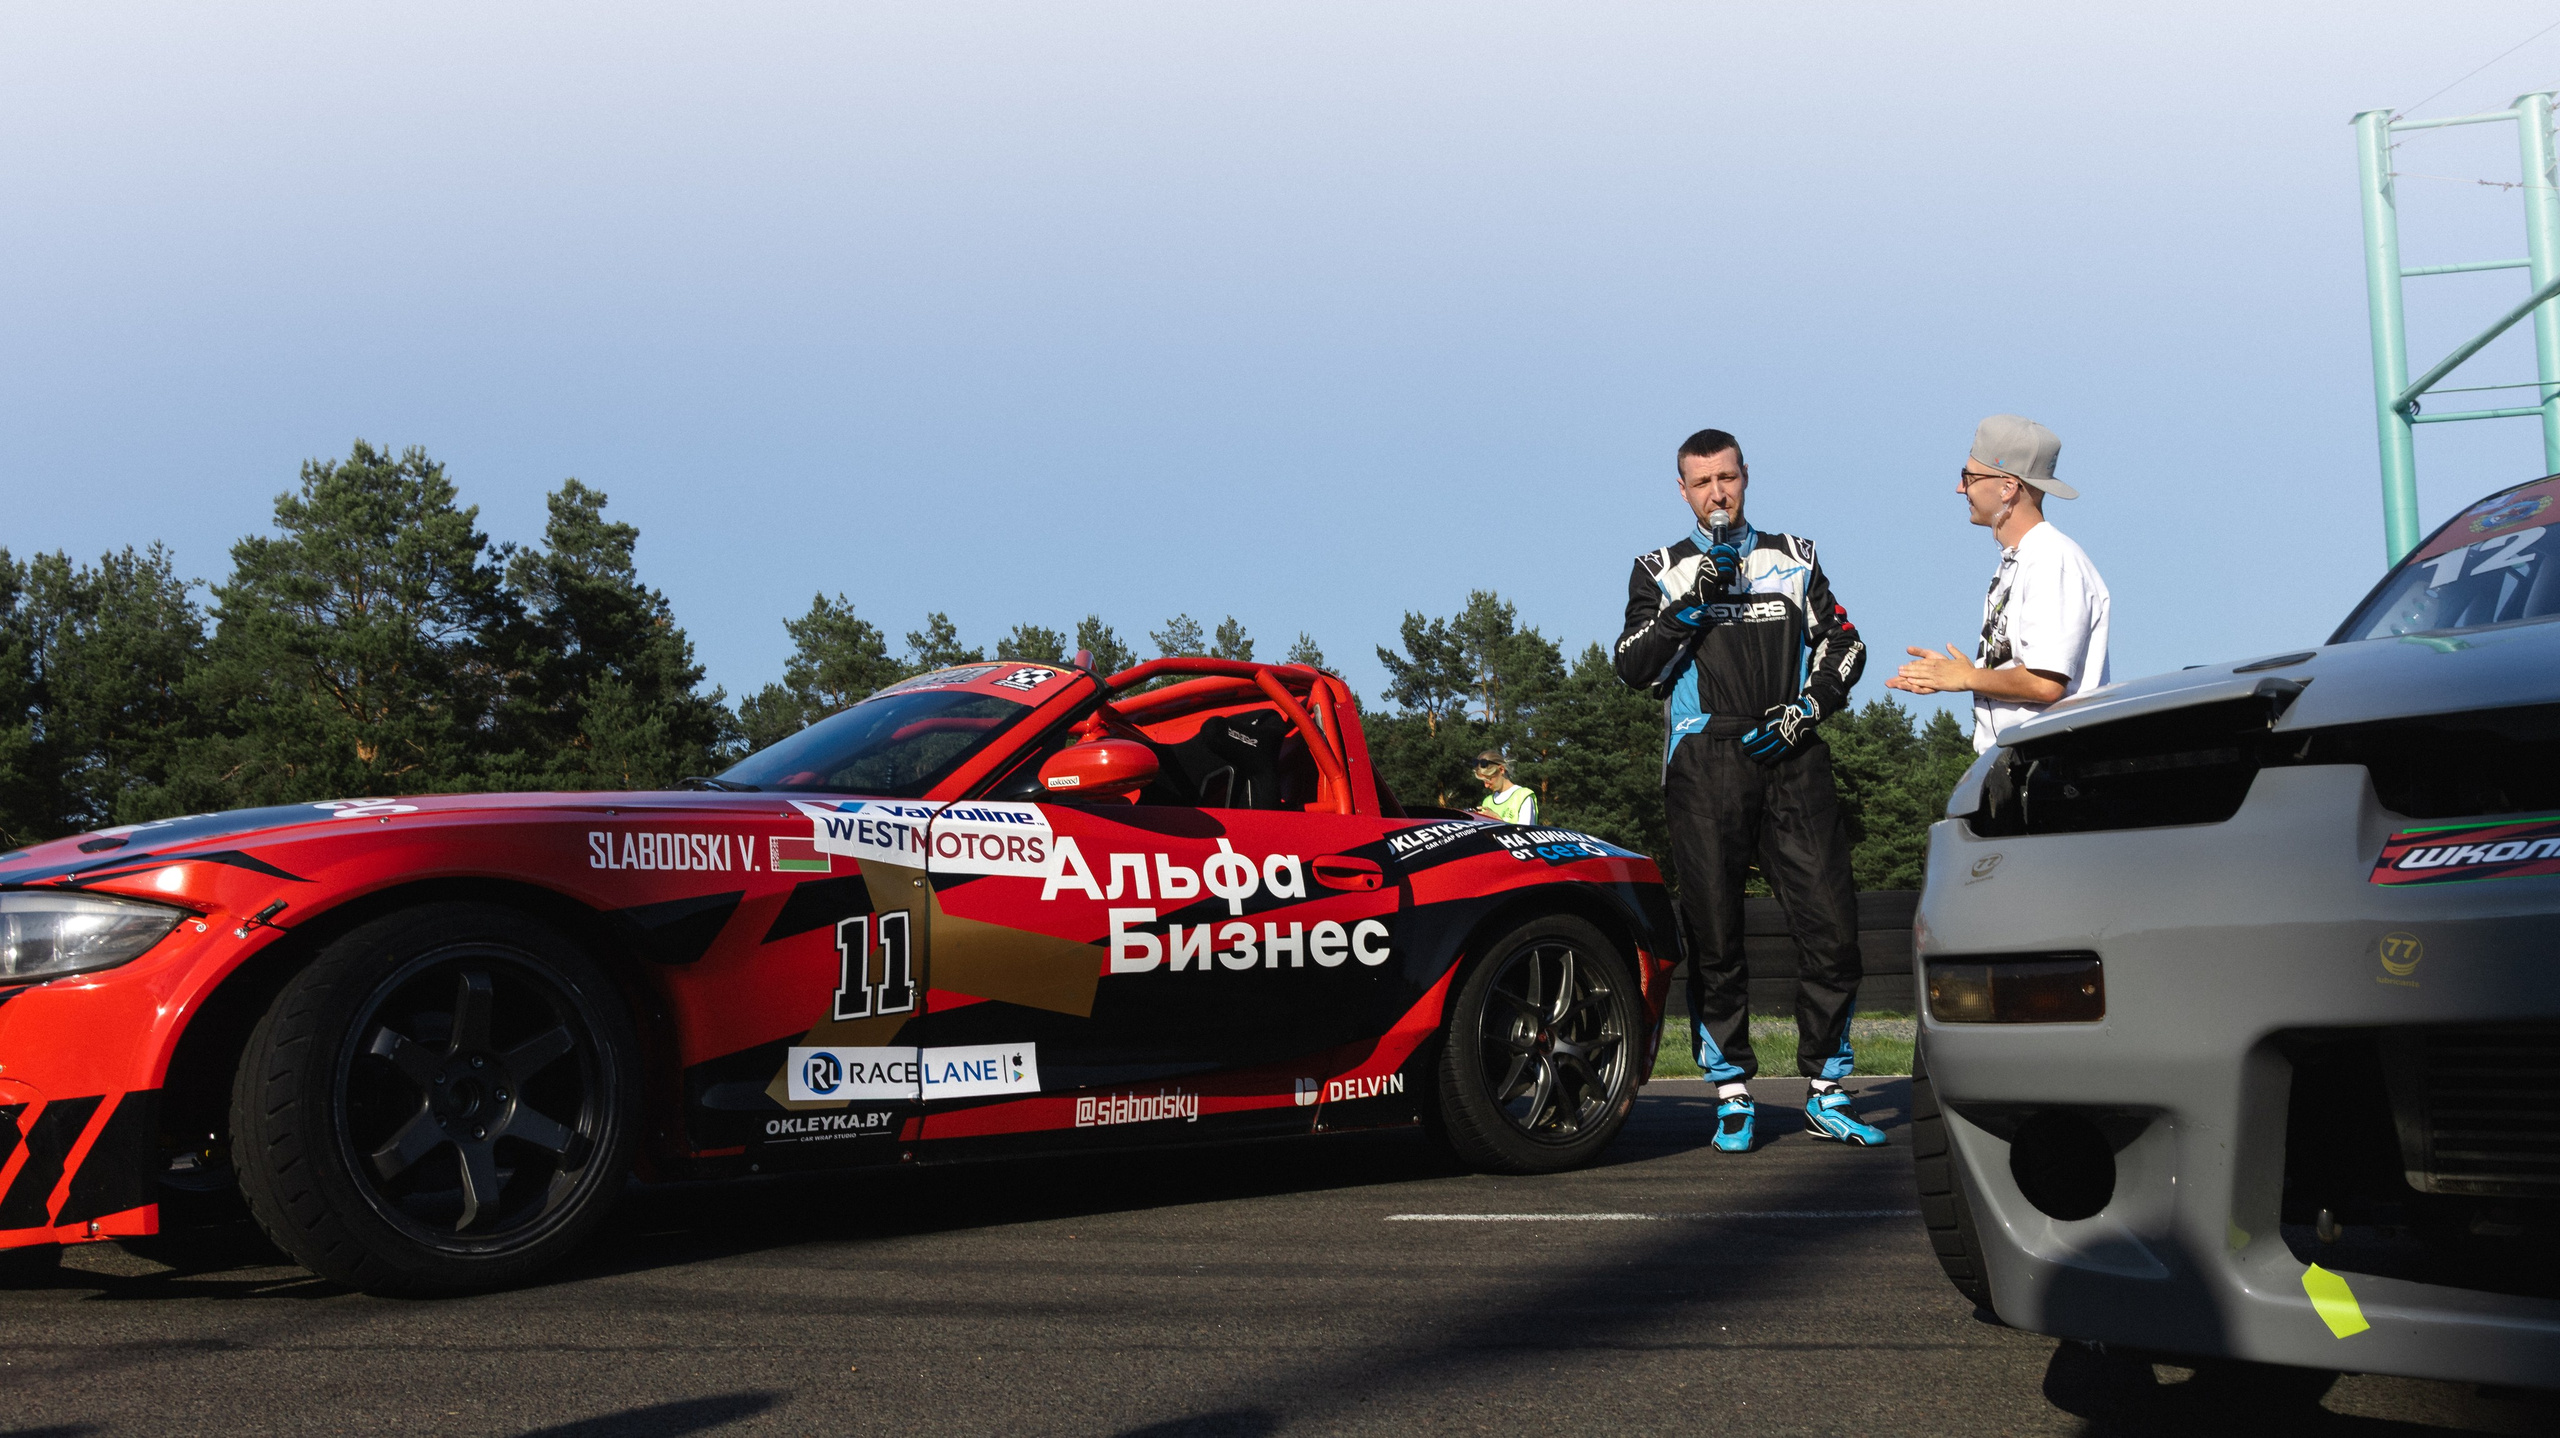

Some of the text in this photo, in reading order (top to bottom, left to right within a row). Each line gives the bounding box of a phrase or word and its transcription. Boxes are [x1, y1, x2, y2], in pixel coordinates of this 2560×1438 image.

[2422, 526, 2547, 589] 12
[876, 805, 1036, 825] Valvoline
[588, 832, 761, 872] SLABODSKI V.
[820, 817, 1046, 863] WESTMOTORS
[1497, 833, 1531, 849] НА
[1525, 831, 1593, 844] ШИНАХ
[1040, 836, 1307, 916] Альфа
[1108, 907, 1391, 973] Бизнес
[2386, 938, 2418, 959] 77
[833, 909, 916, 1021] 11
[765, 1112, 893, 1135] OKLEYKA.BY
[1075, 1087, 1199, 1128] @slabodsky
